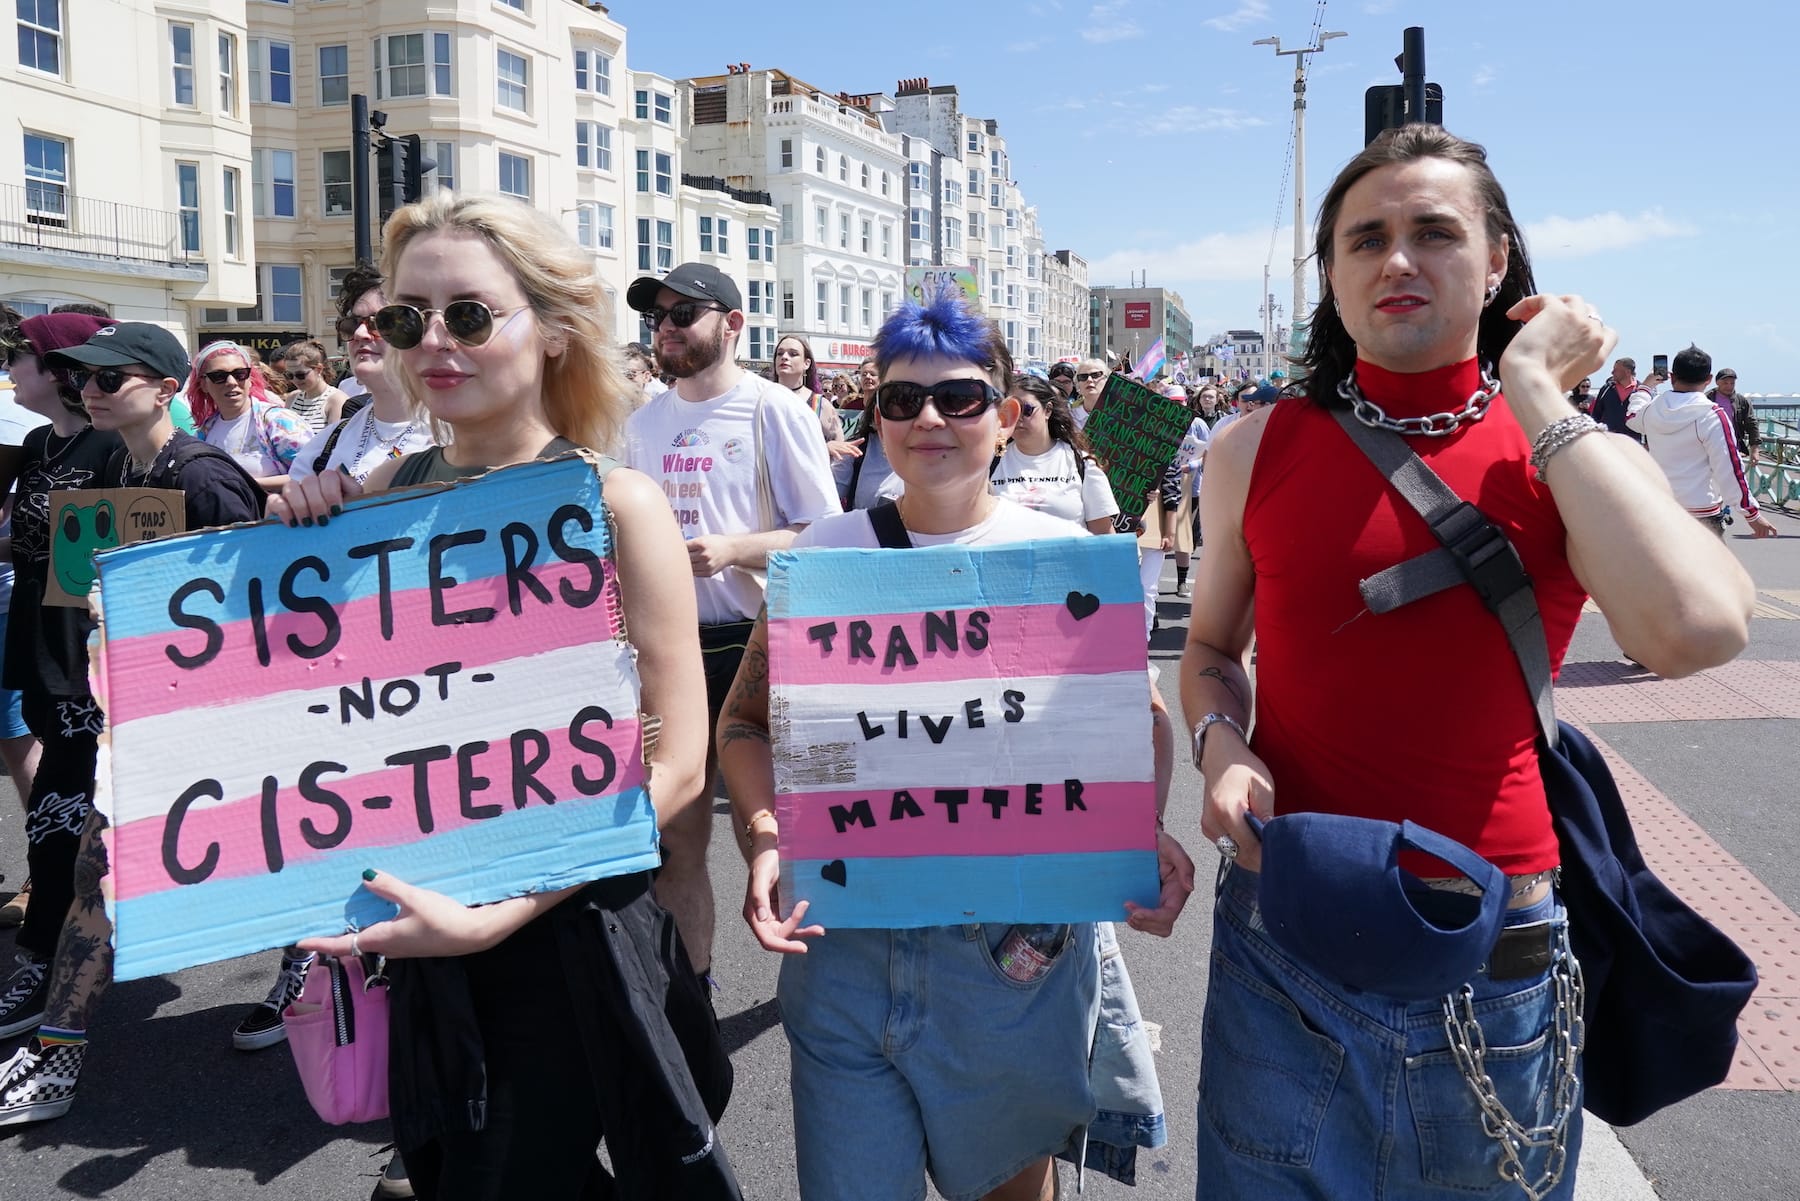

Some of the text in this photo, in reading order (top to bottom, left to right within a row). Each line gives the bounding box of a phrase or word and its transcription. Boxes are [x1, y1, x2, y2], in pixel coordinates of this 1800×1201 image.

[923, 271, 957, 284] FUCK
[1110, 375, 1193, 428] THEIR GENDER
[1104, 395, 1185, 444] WAS ABOUT
[662, 453, 713, 474] Where
[1084, 428, 1161, 479] THEMSELVES
[1158, 443, 1179, 464] FOR
[662, 479, 705, 499] Queer
[1007, 475, 1026, 484] PINK
[1028, 475, 1059, 483] TENNIS
[1107, 466, 1153, 498] NO ONE
[671, 504, 699, 529] ope
[1112, 486, 1145, 516] OULD
[130, 510, 166, 529] TOADS
[165, 504, 605, 669] SISTERS
[808, 610, 991, 668] TRANS
[857, 689, 1026, 744] LIVES
[160, 705, 617, 886] CIS-TERS
[828, 779, 1088, 833] MATTER
